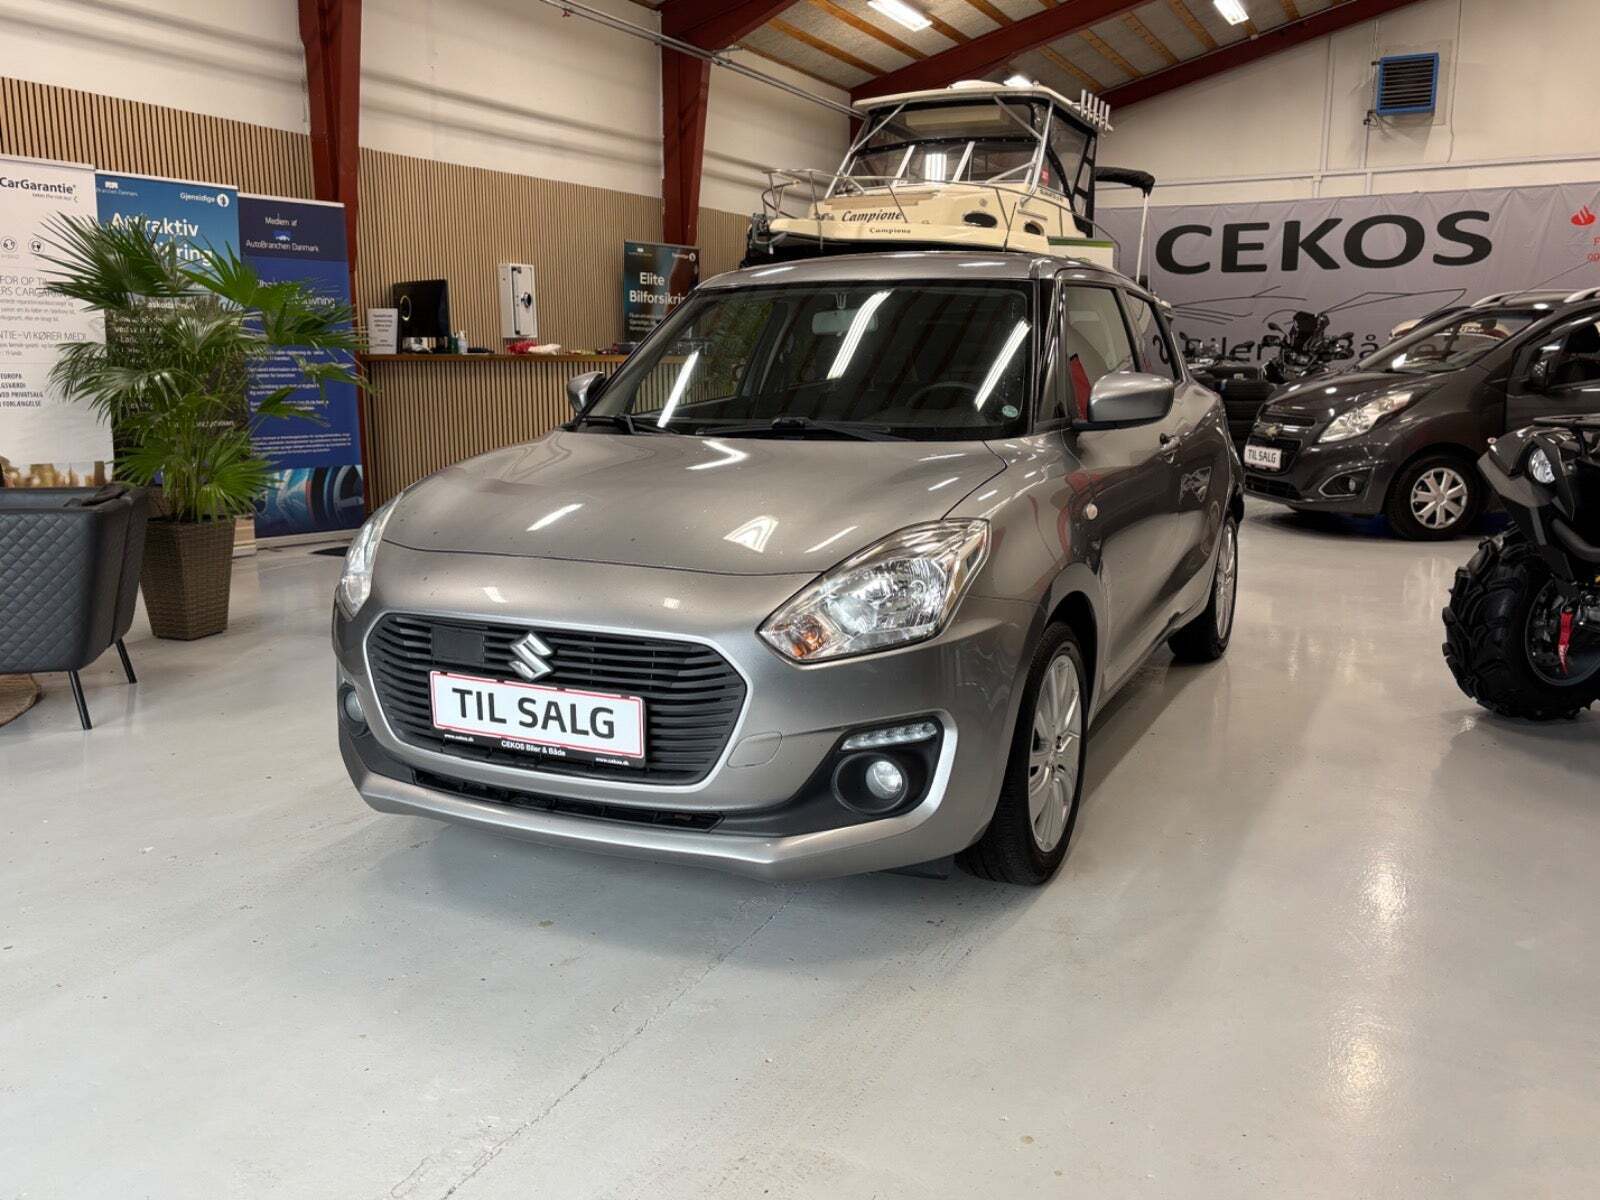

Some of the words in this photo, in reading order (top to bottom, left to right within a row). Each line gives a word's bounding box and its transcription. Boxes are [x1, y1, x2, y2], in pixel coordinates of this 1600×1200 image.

[0, 177, 74, 194] CarGarantie
[180, 192, 216, 203] Gjensidige
[265, 217, 290, 226] Medlem
[246, 240, 290, 251] AutoBranchen
[292, 243, 319, 252] Danmark
[1156, 210, 1493, 275] CEKOS
[640, 272, 665, 286] Elite
[452, 687, 507, 724] TIL
[517, 697, 615, 739] SALG
[501, 740, 525, 751] CEKOS
